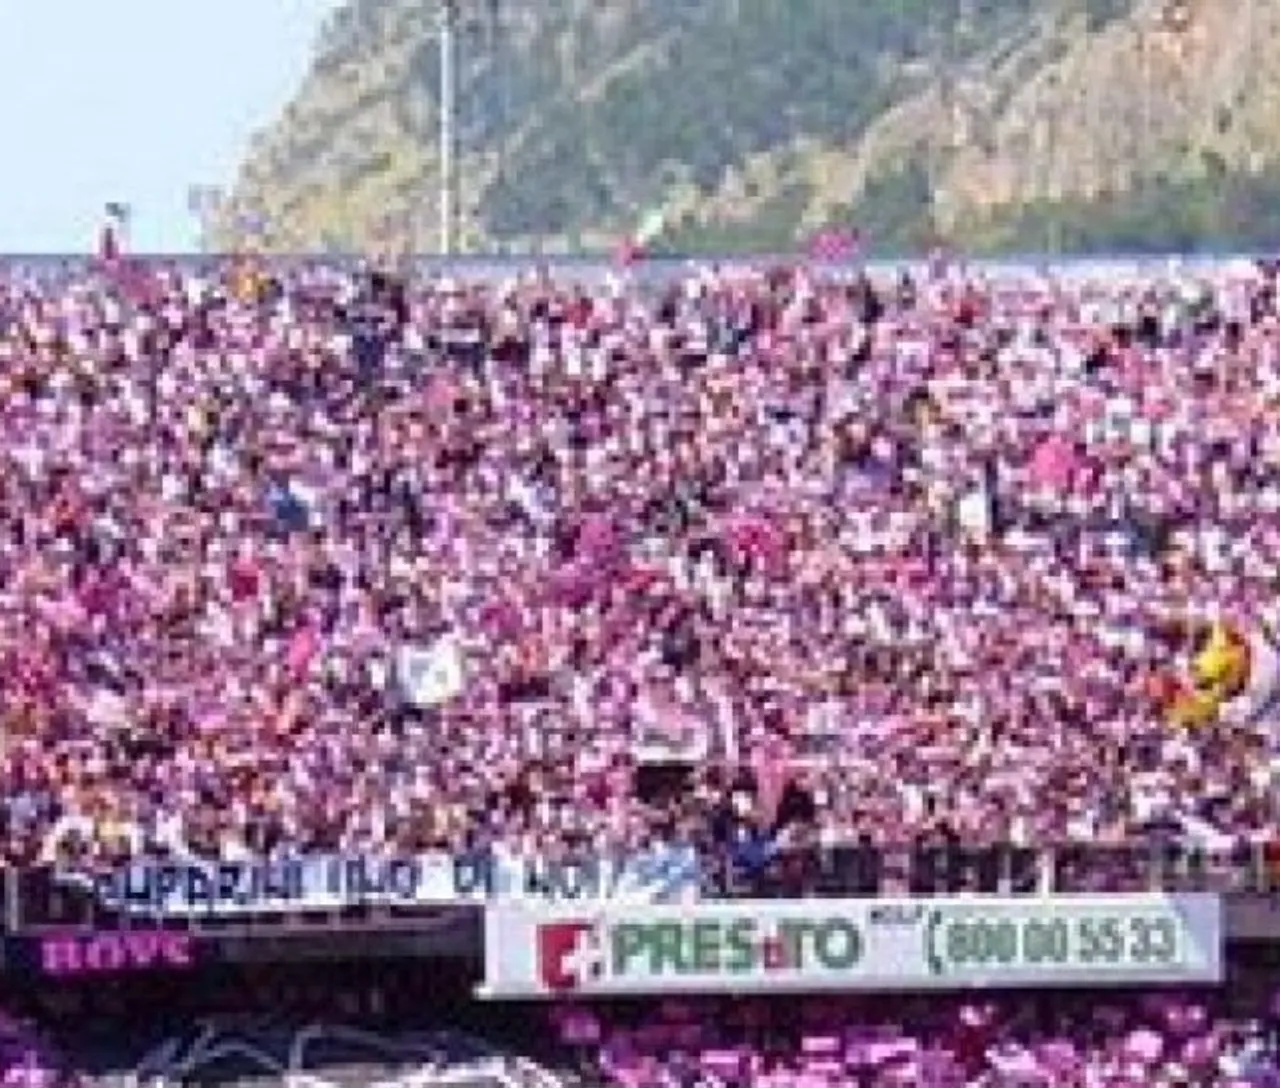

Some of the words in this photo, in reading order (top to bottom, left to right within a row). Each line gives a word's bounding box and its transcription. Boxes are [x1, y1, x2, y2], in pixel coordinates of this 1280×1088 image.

[40, 930, 192, 977] BOYS
[1078, 917, 1123, 962] 55
[1129, 916, 1176, 961] 33
